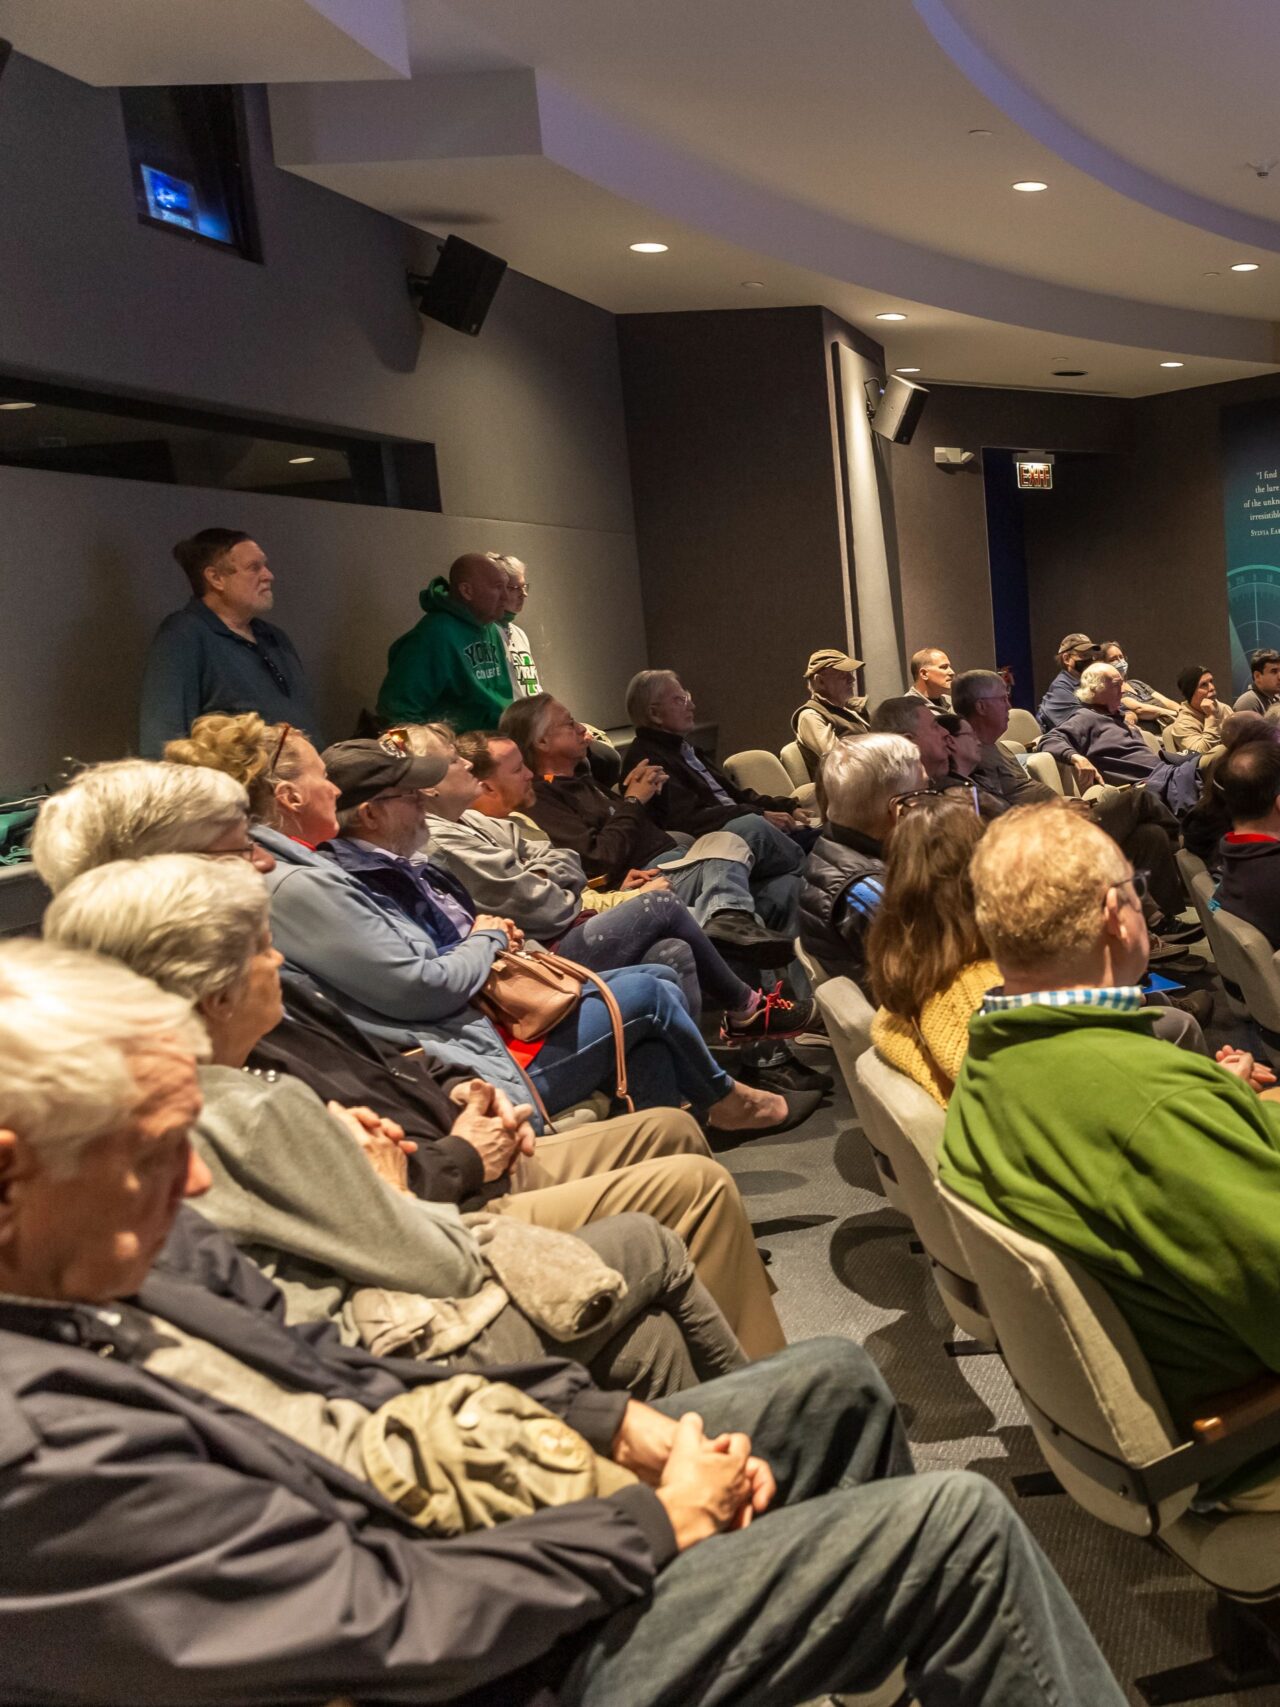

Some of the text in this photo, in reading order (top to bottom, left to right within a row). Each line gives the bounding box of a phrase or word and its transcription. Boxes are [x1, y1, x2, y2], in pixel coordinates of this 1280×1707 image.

[1264, 469, 1277, 479] find
[1255, 484, 1280, 493] the lure
[1243, 500, 1250, 508] of
[1252, 499, 1261, 507] the
